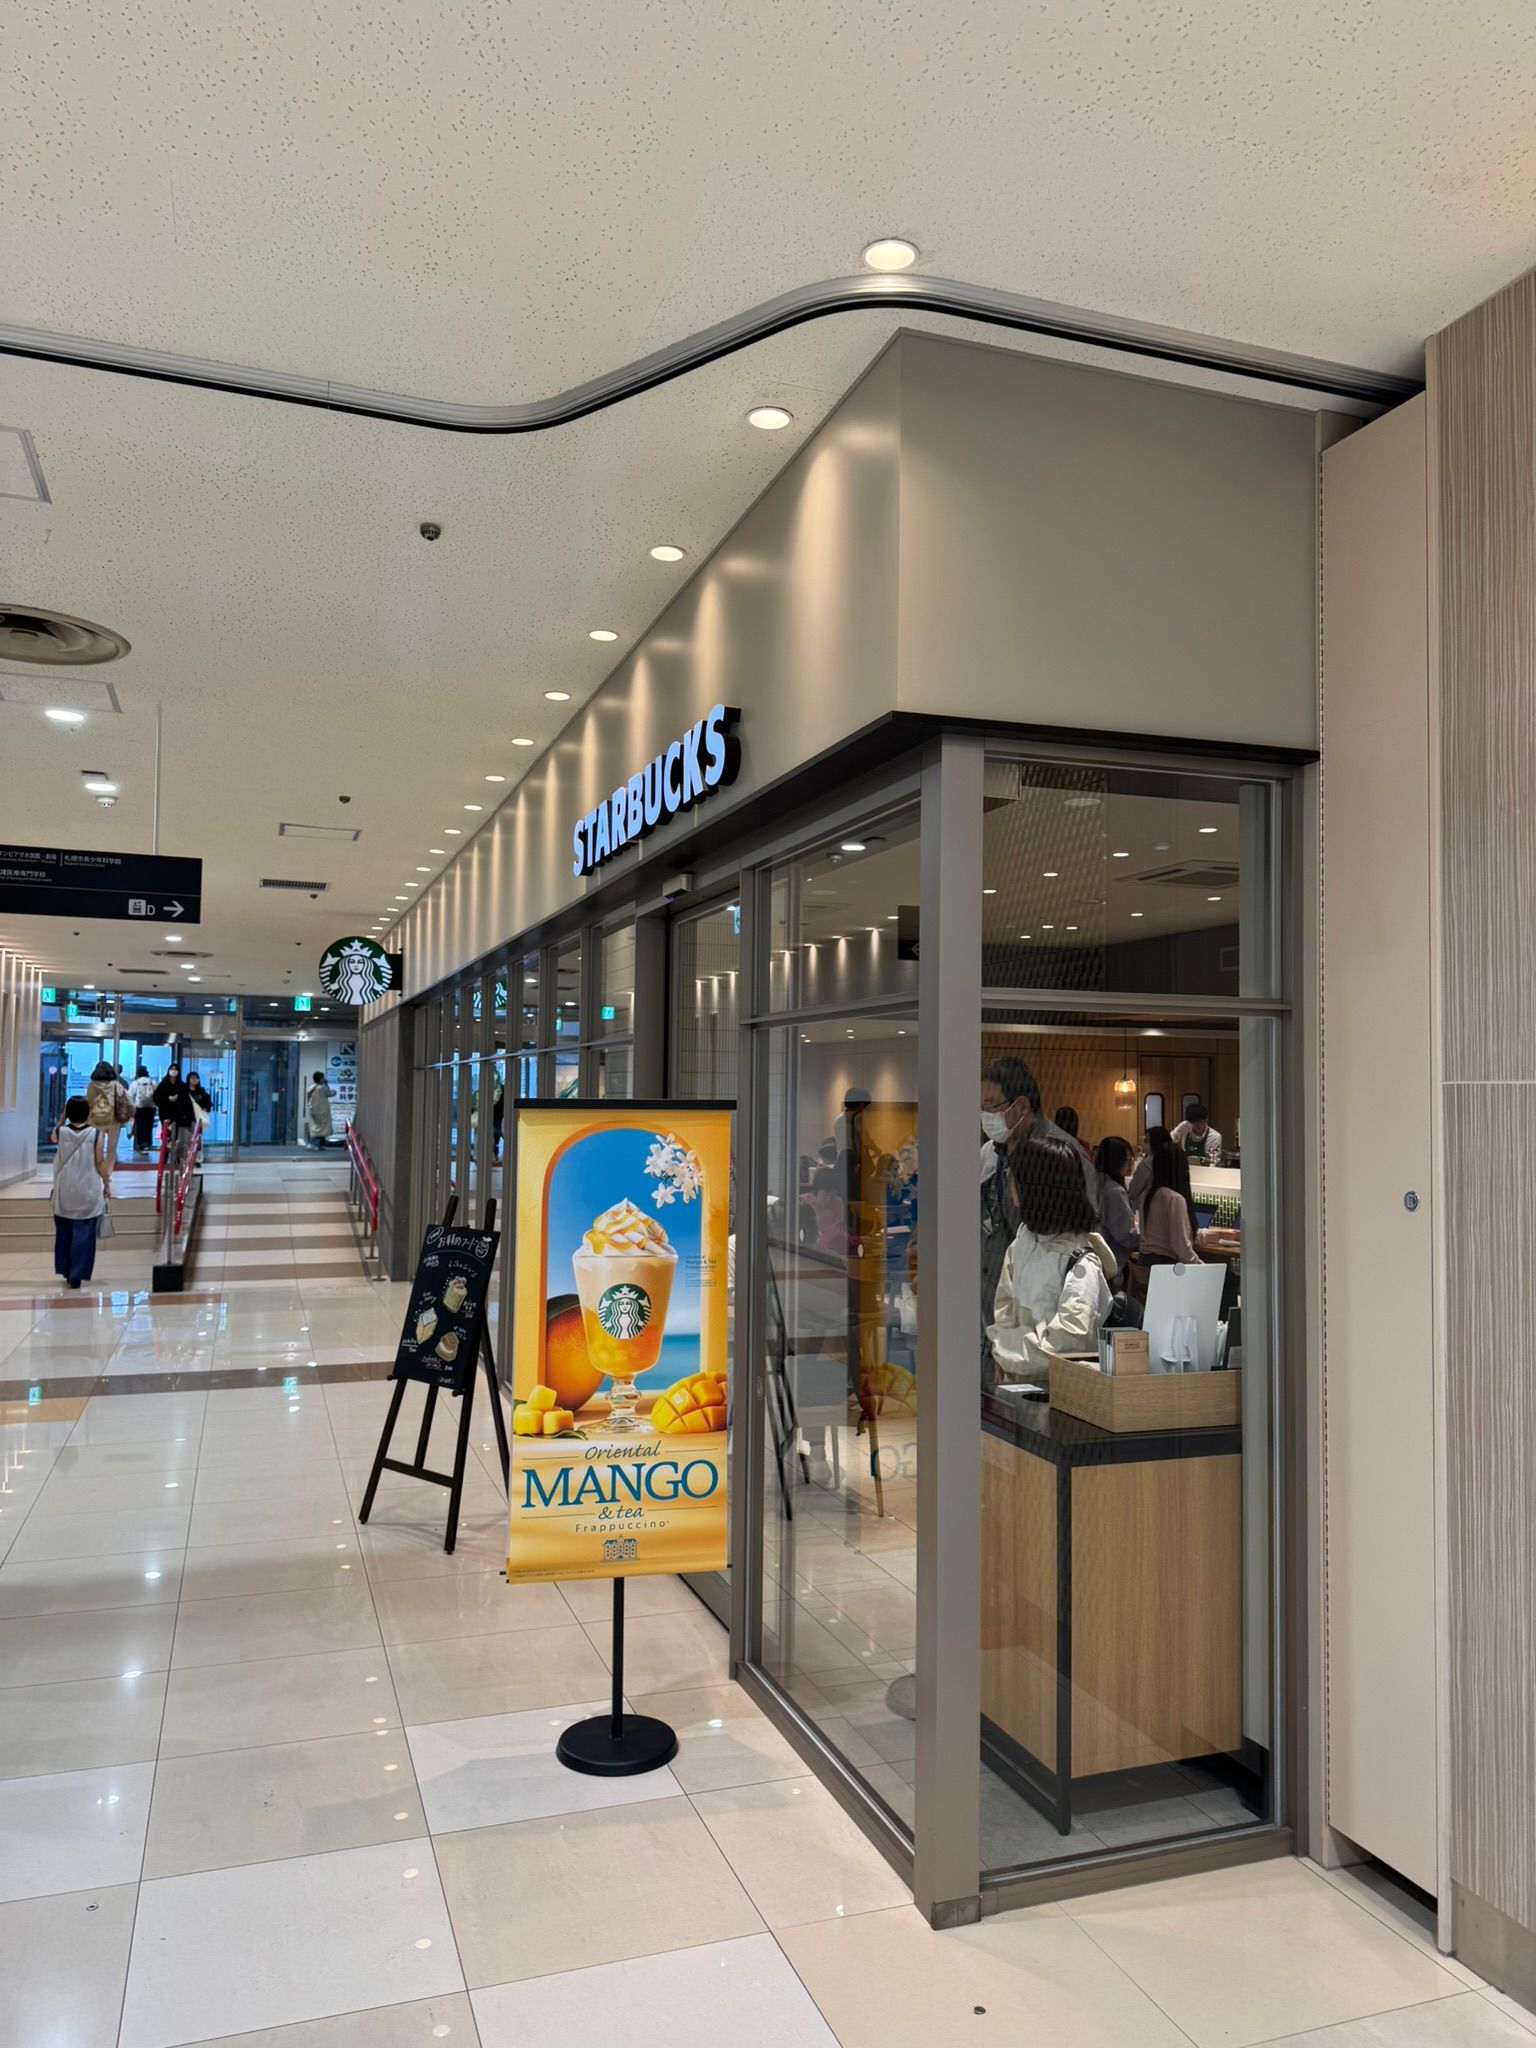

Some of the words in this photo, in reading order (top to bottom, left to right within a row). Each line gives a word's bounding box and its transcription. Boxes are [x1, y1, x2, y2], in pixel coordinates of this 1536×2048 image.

[573, 703, 728, 877] STARBUCKS
[147, 904, 155, 916] D
[584, 1439, 662, 1460] Oriental
[521, 1459, 719, 1508] MANGO
[598, 1506, 614, 1520] &
[617, 1505, 645, 1519] tea
